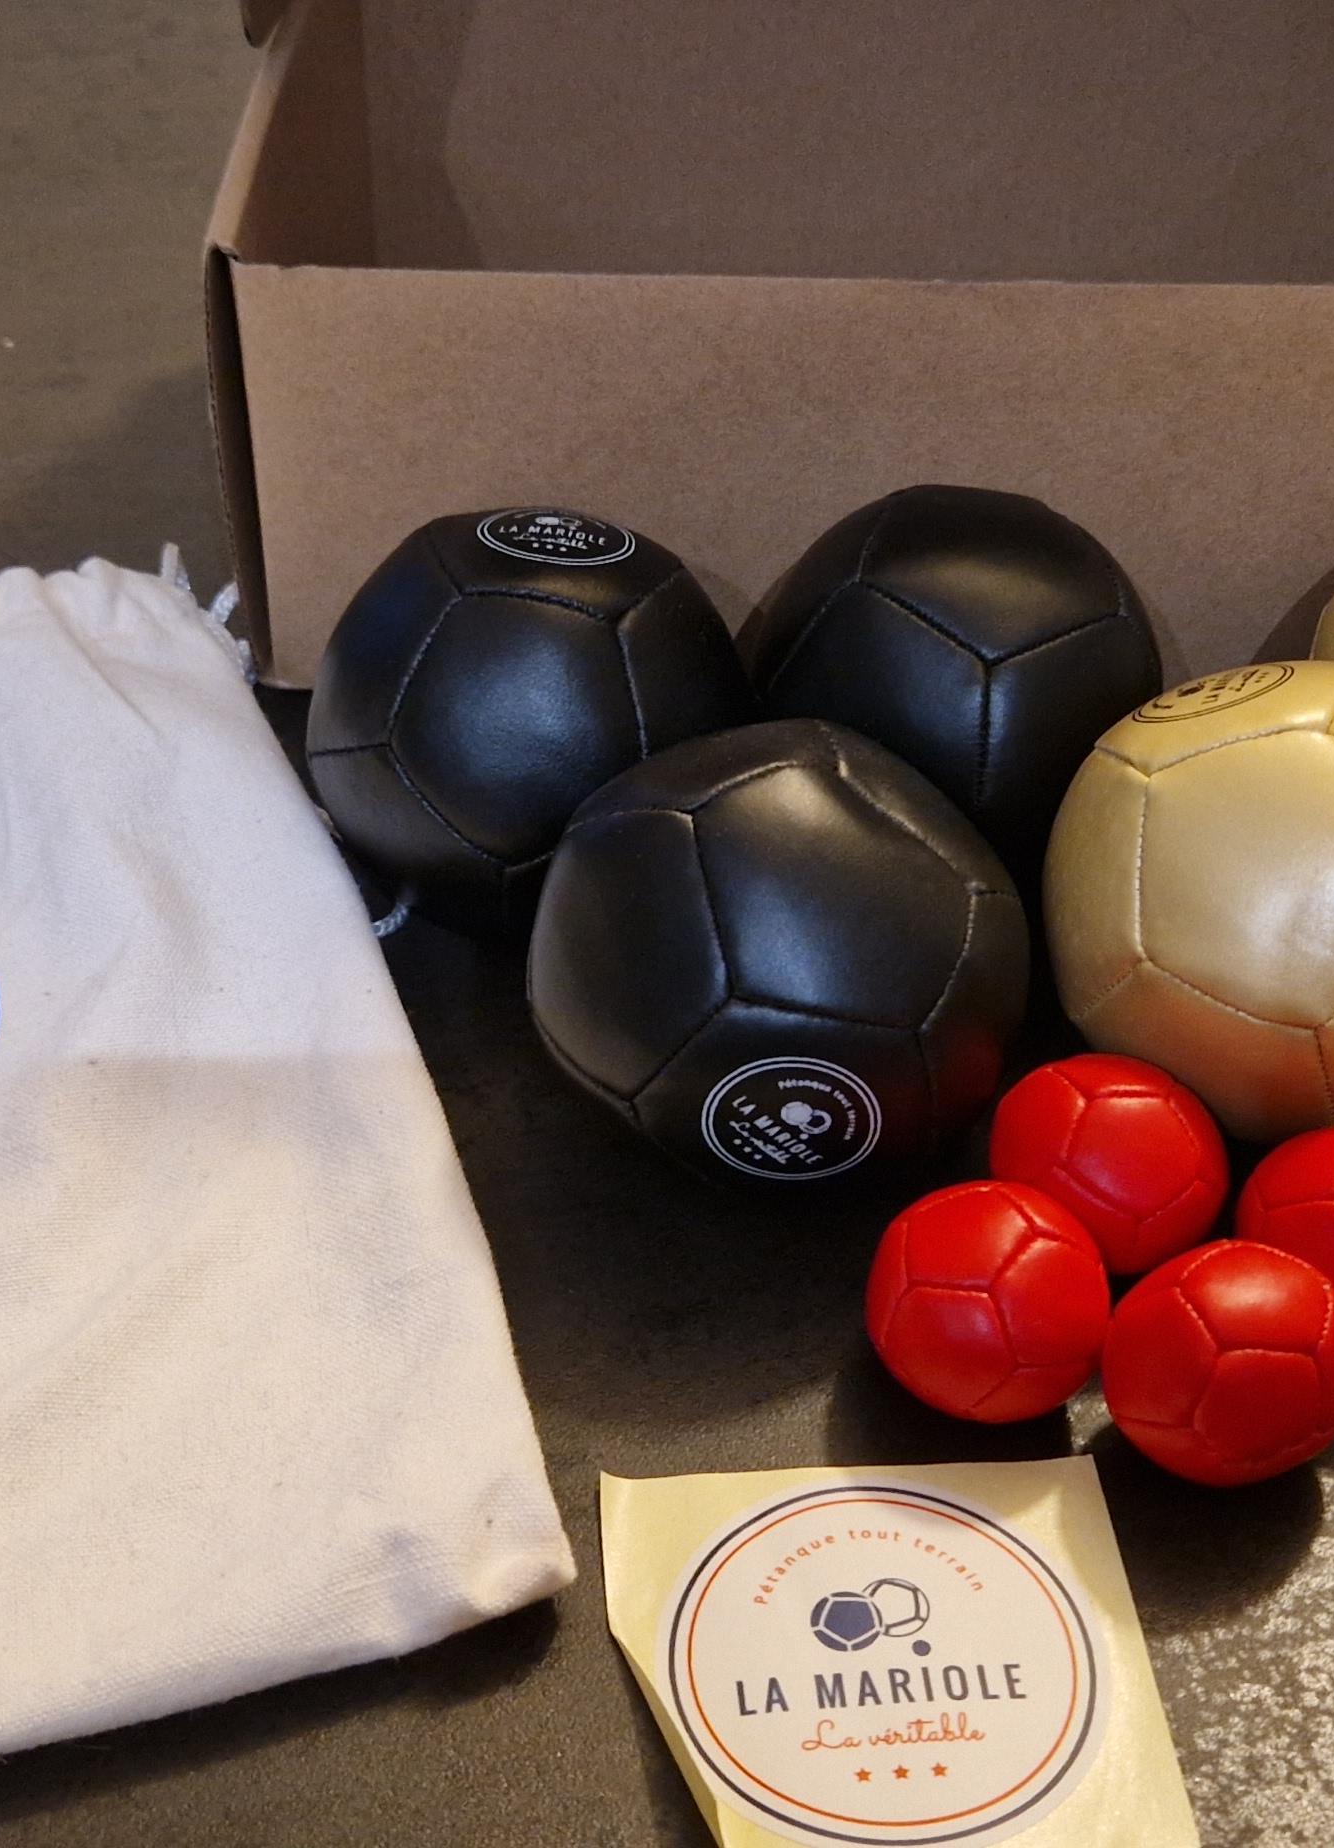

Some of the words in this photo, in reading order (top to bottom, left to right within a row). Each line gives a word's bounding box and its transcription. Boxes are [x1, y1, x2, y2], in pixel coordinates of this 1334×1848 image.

[499, 525, 518, 533] LA
[528, 525, 606, 546] MARIOLE
[732, 1095, 757, 1116] LA
[753, 1114, 824, 1165] MARIOLE
[753, 1534, 836, 1606] Pétanque
[848, 1529, 901, 1542] tout
[913, 1537, 984, 1592] terrain
[736, 1676, 789, 1716] LA
[814, 1663, 1027, 1710] MARIOLE
[801, 1719, 862, 1751] La
[868, 1711, 986, 1746] véritable
